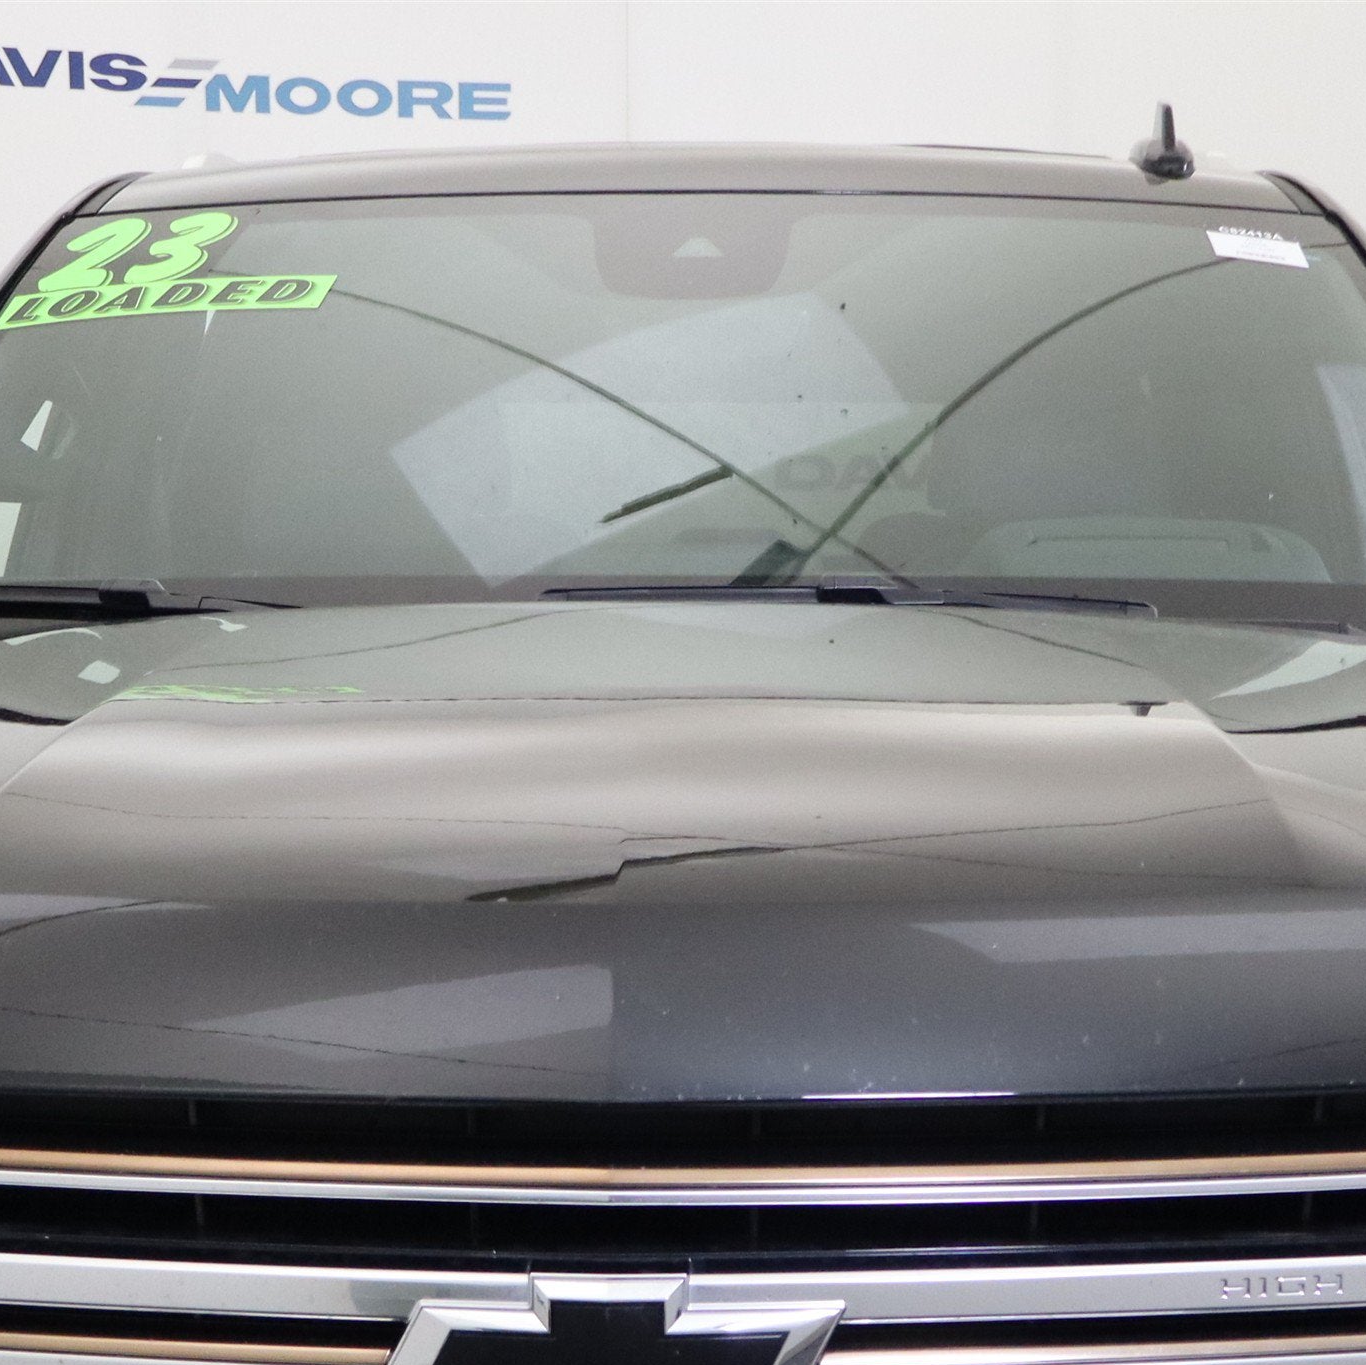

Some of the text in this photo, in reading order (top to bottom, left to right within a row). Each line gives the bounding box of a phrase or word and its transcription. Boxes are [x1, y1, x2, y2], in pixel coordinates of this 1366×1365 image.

[204, 72, 512, 121] MOORE
[37, 212, 238, 292] 23
[5, 278, 314, 324] LOADED
[1219, 1274, 1344, 1299] HIGH
